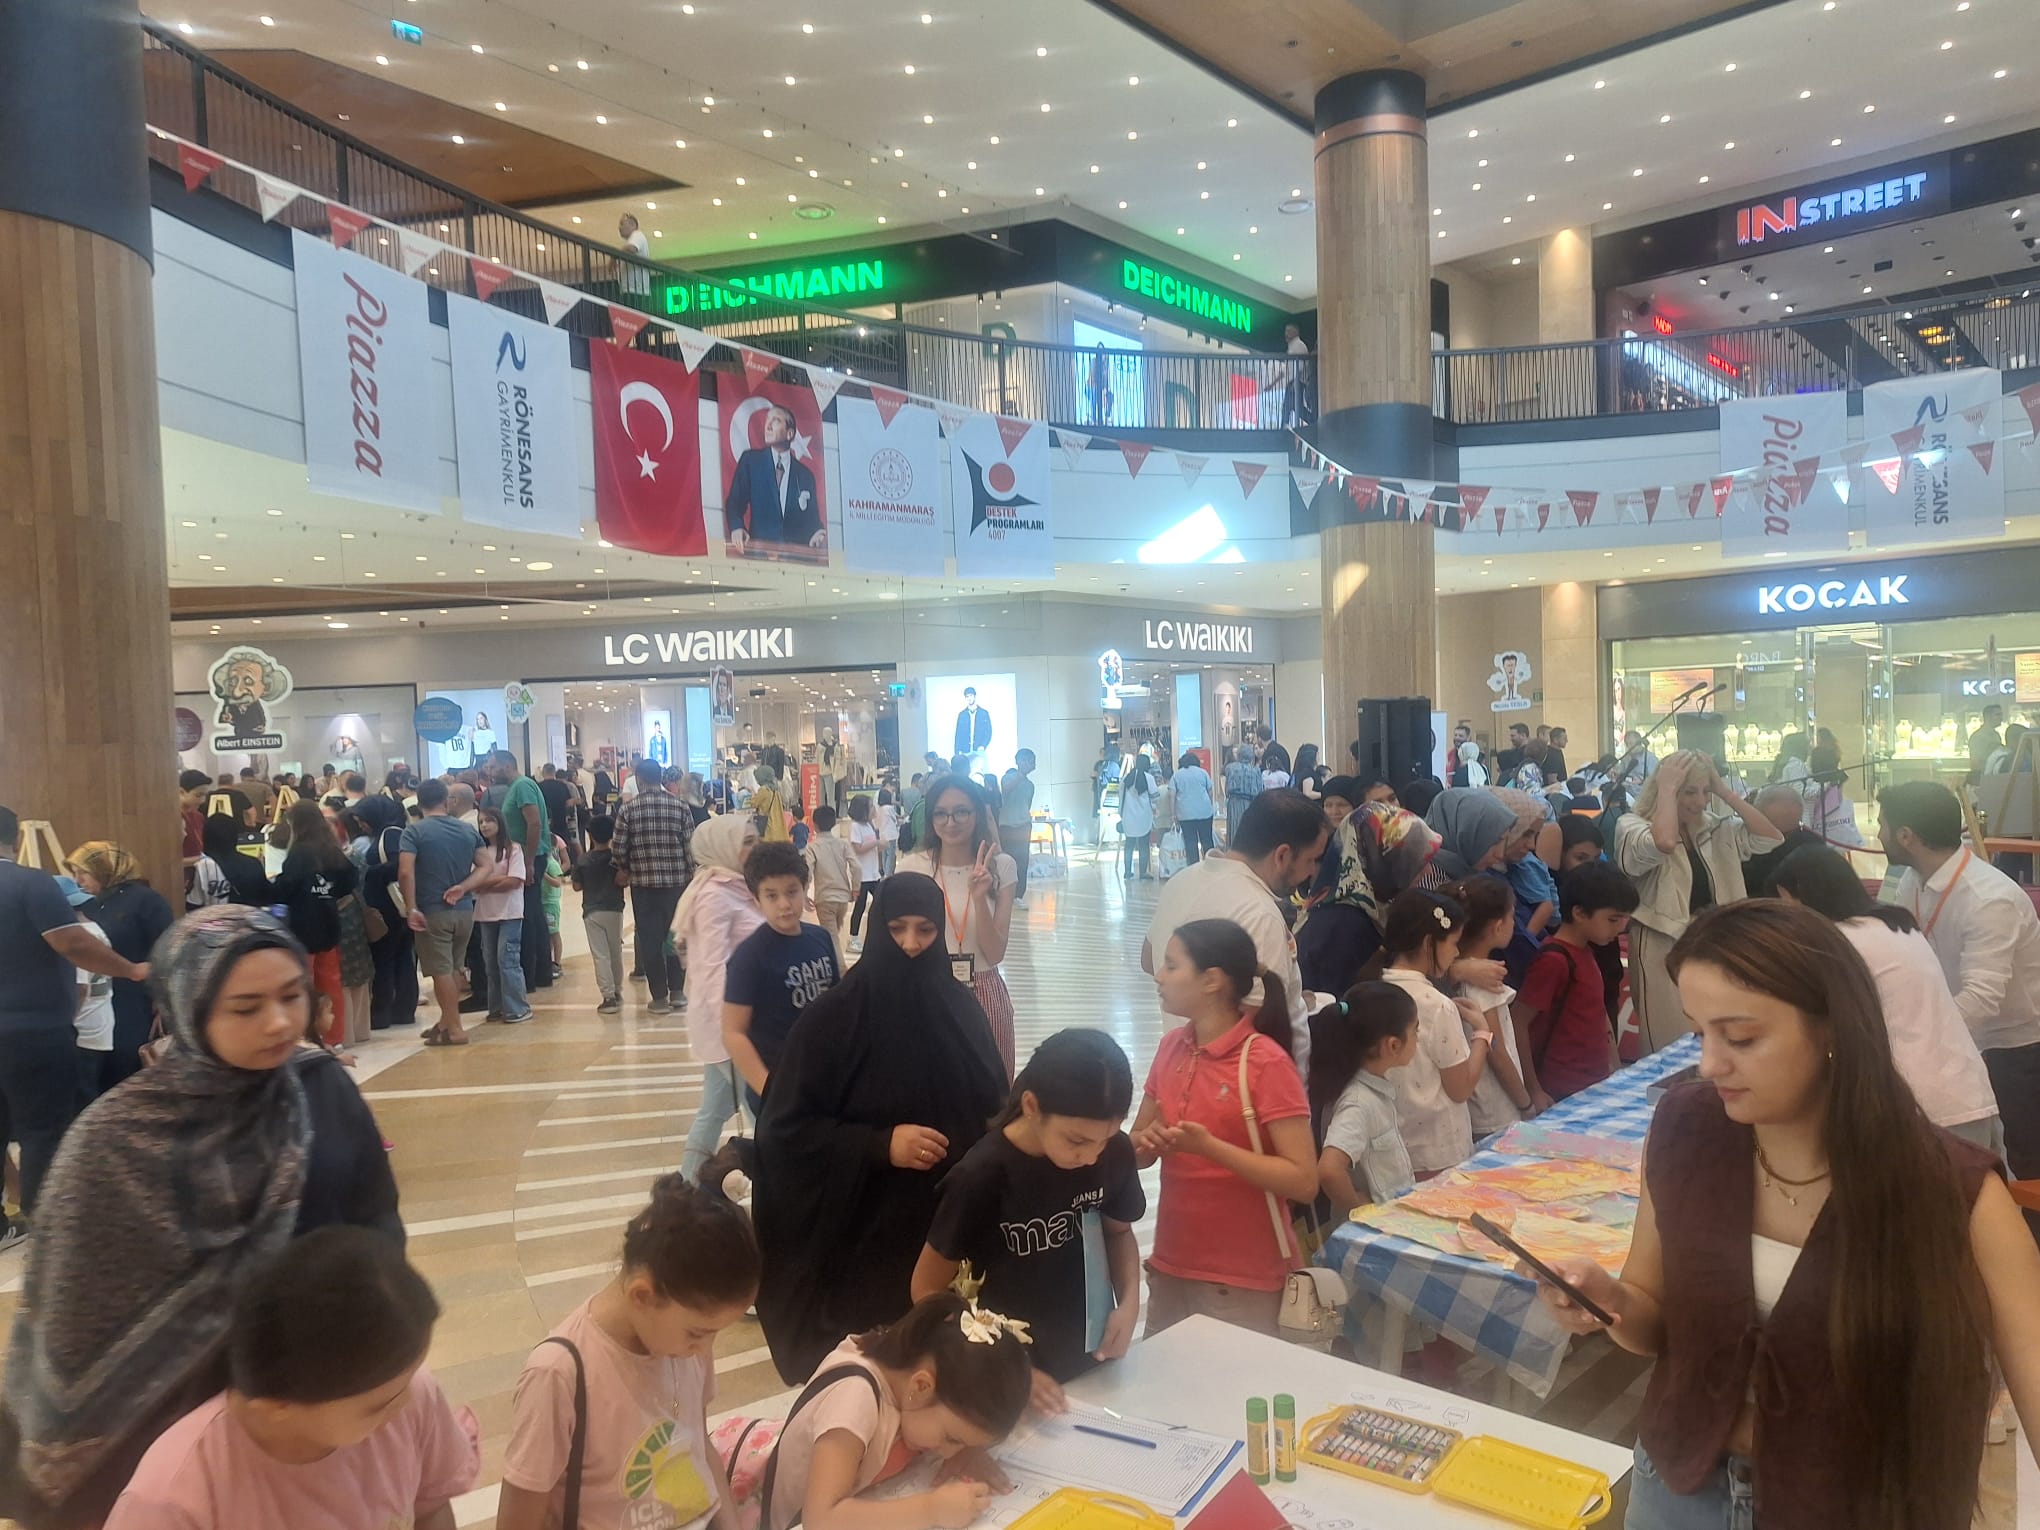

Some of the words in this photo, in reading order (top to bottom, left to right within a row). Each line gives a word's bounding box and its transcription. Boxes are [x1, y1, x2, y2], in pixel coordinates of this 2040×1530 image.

[666, 260, 884, 315] DEICHMANN
[1123, 259, 1251, 333] DEICHMANN
[343, 272, 388, 478] Piazza
[496, 380, 515, 505] GAYRİMENKUL
[512, 383, 534, 508] RÖNESANS
[1931, 433, 1954, 524] RÖSANS
[848, 498, 935, 518] KAHRAMANMARAŞ
[986, 506, 1017, 517] DESTEK
[987, 519, 1044, 531] PROGRAMLARI
[988, 530, 1006, 540] 4007
[604, 633, 650, 665] LC
[1145, 620, 1174, 650] LC
[217, 737, 240, 748] Albert
[242, 737, 281, 747] EINSTEIN
[788, 956, 832, 987] GAME
[630, 1502, 663, 1526] ICE
